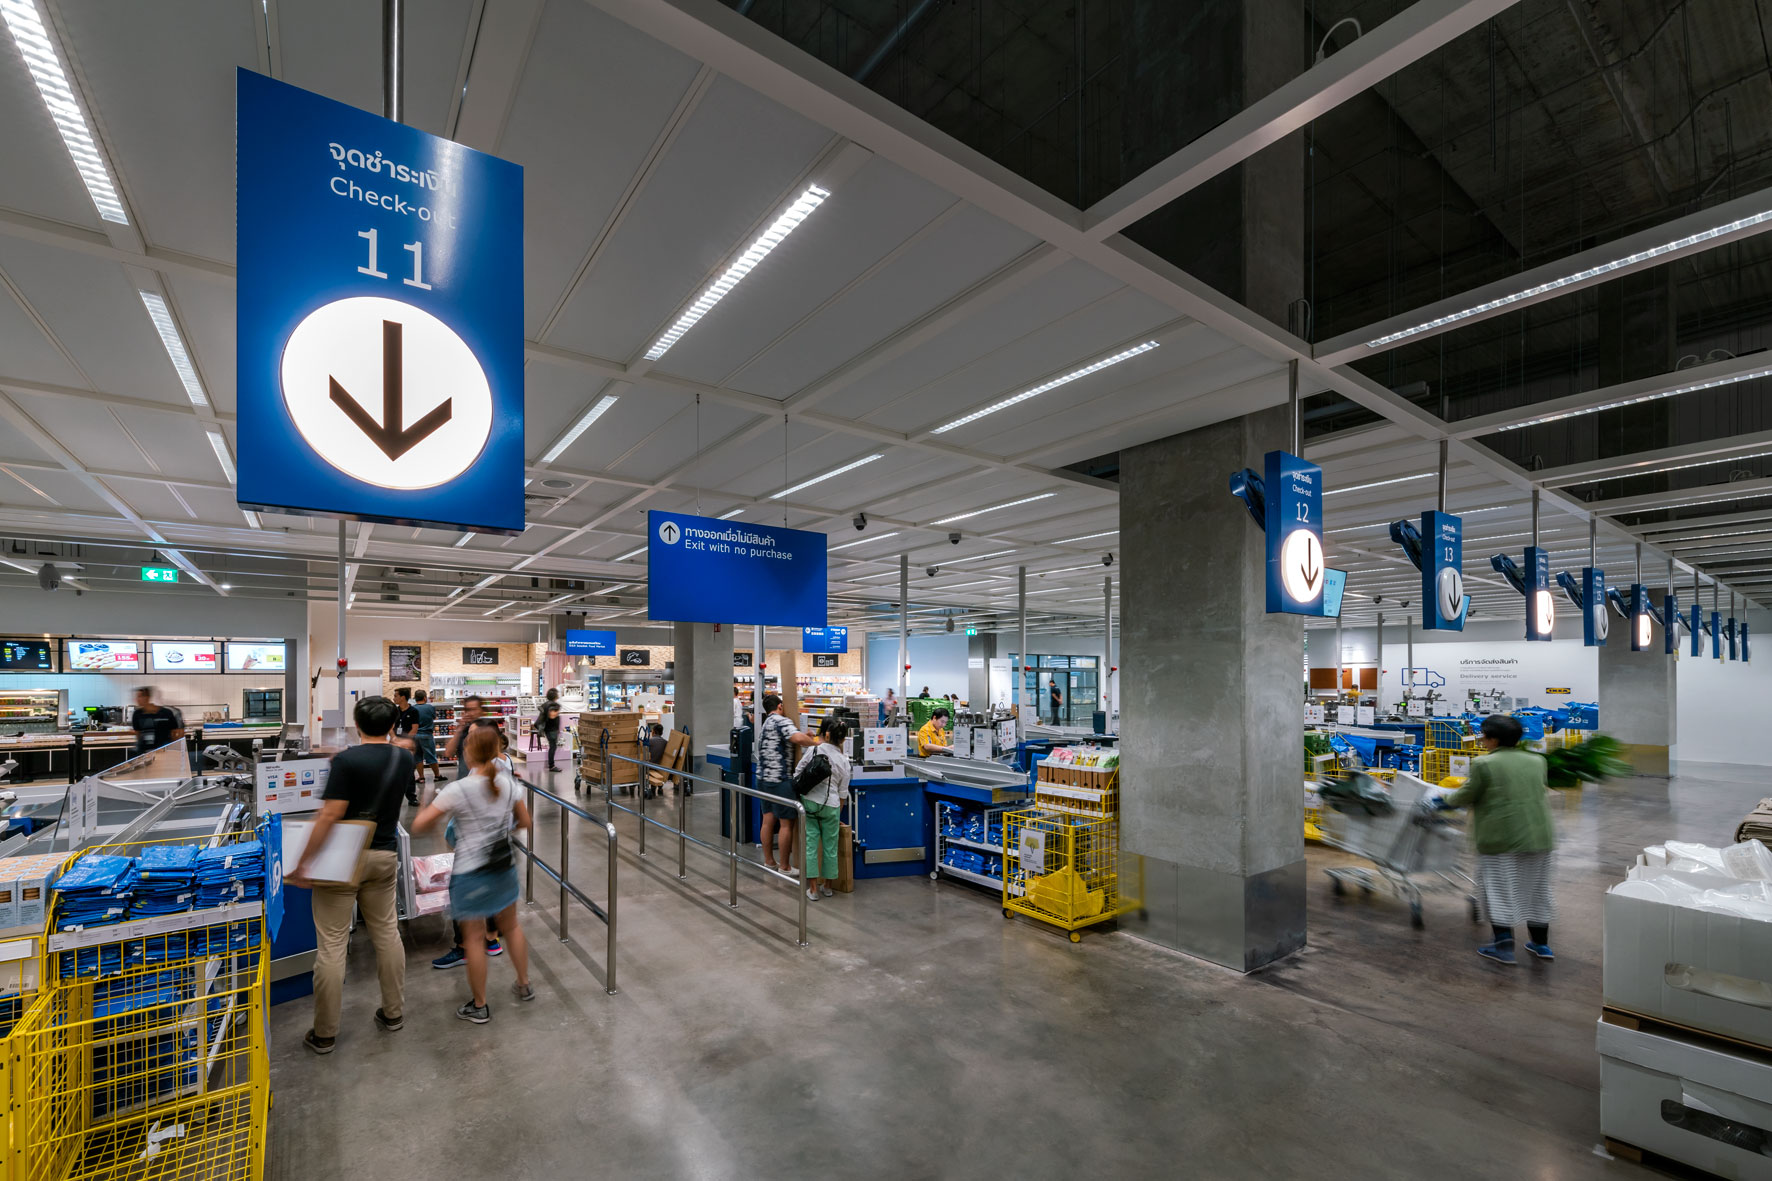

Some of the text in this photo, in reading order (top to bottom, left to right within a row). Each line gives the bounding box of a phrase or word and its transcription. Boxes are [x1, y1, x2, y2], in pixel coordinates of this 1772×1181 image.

[357, 227, 432, 291] 11
[1292, 484, 1313, 497] Check-out
[1296, 501, 1310, 524] 12
[685, 539, 793, 560] Exit with no purchase
[1444, 546, 1454, 562] 13
[1568, 716, 1582, 724] 29
